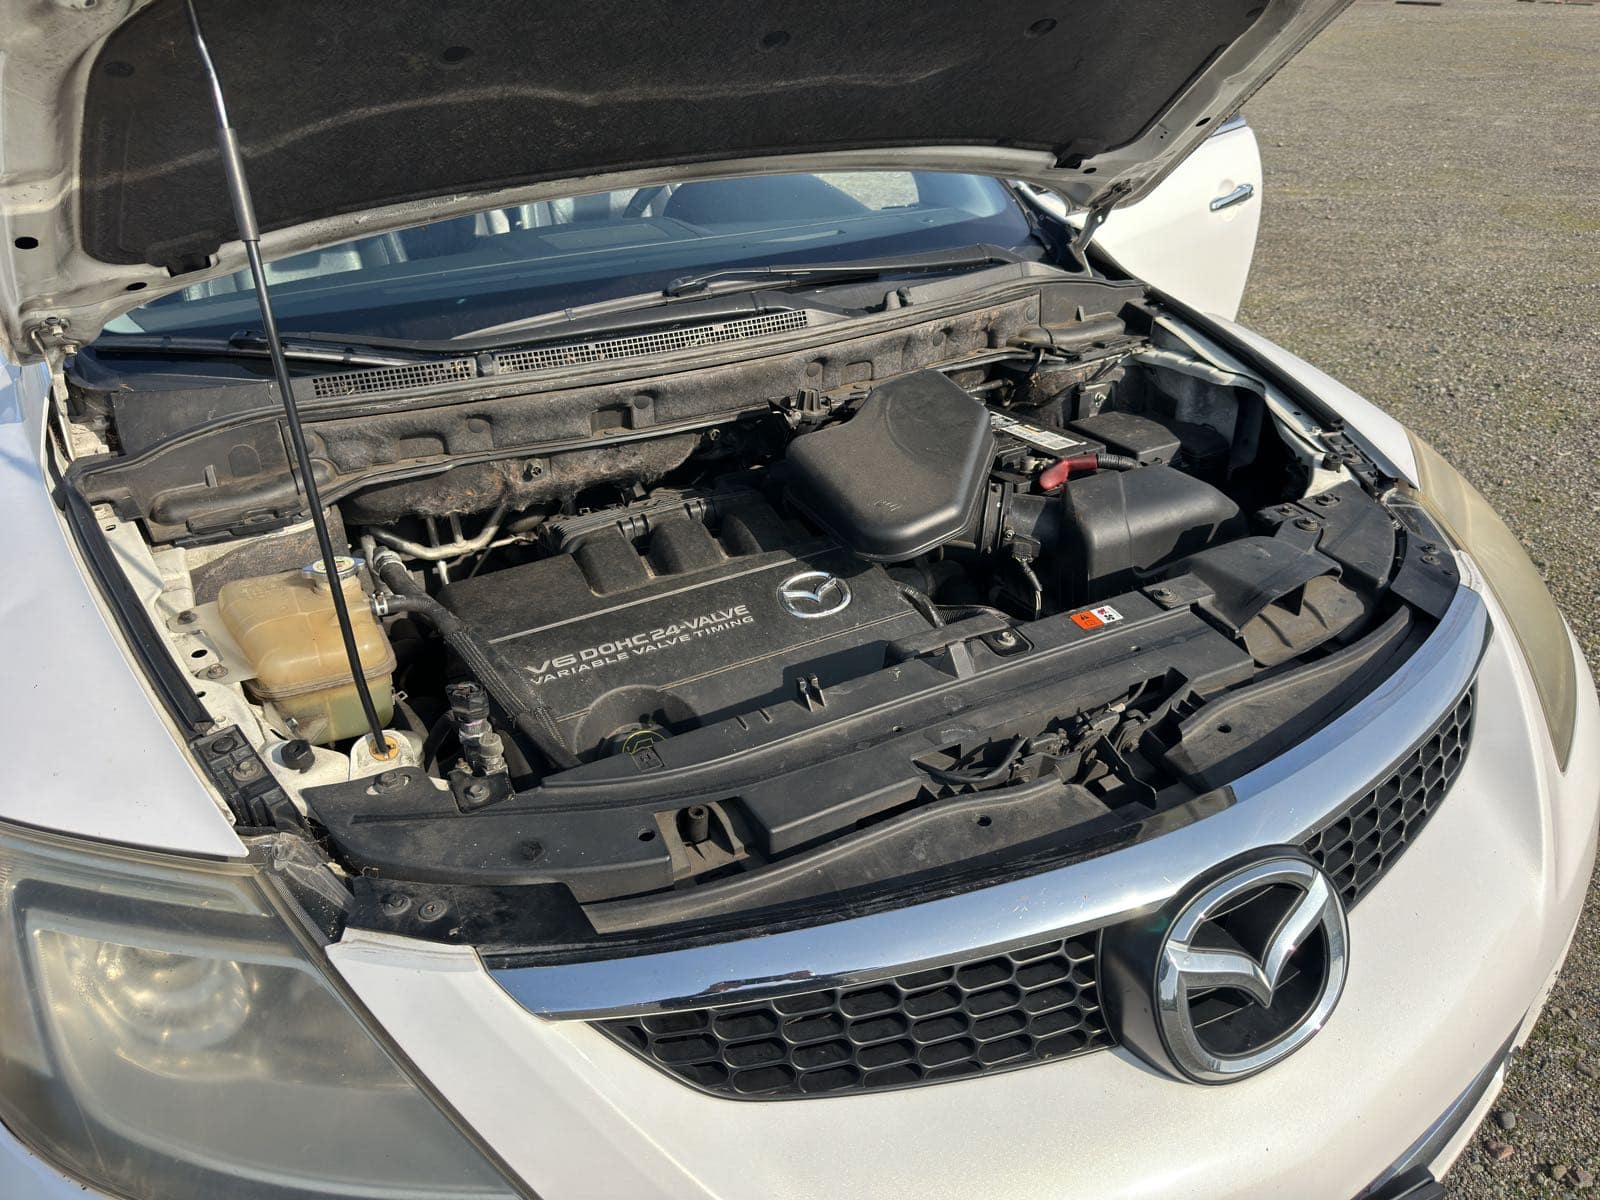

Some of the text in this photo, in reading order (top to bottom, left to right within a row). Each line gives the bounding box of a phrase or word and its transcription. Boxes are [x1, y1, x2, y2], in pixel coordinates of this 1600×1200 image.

[523, 604, 749, 674] V6 DOHC 24-VALVE
[530, 615, 754, 685] VARIABLE VALVE TIMING
